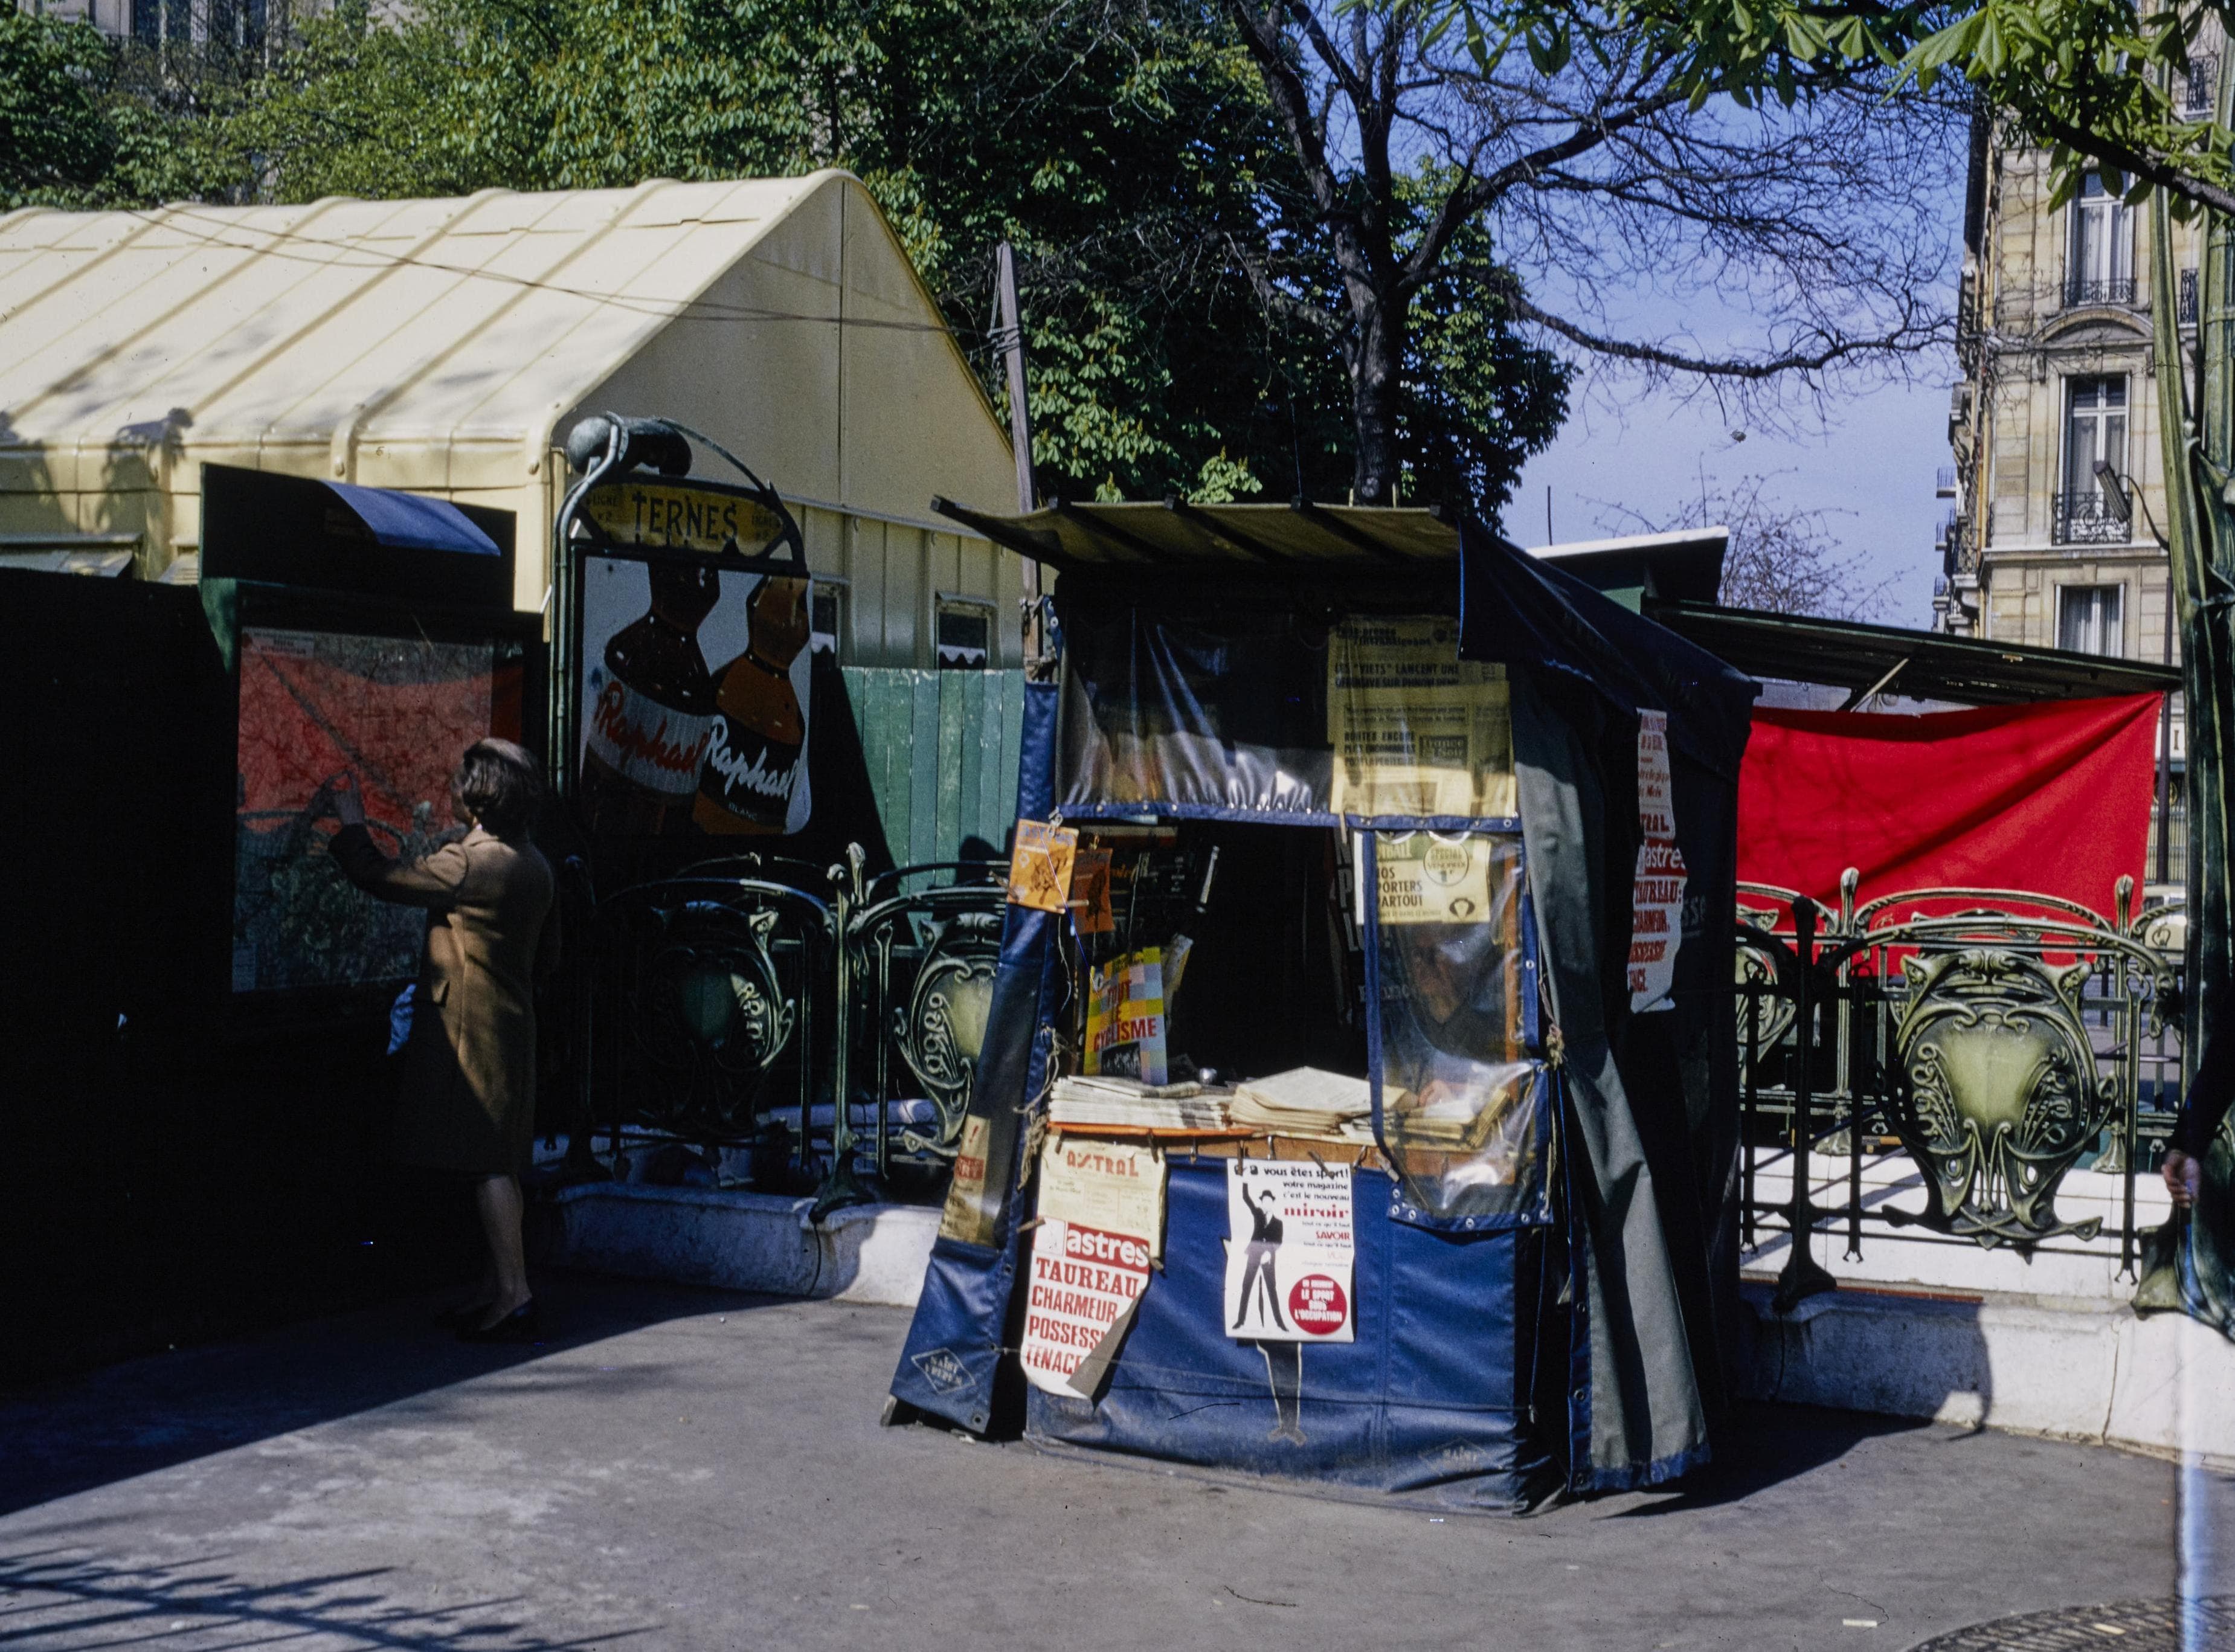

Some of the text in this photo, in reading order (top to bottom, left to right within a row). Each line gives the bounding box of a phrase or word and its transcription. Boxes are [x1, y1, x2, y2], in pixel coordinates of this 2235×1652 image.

[632, 490, 738, 541] TERNES
[728, 802, 758, 821] BLANC
[1377, 866, 1395, 879] OS
[1378, 895, 1423, 908] ARTOUT
[1067, 1150, 1139, 1178] ASTRAL
[1264, 1166, 1349, 1180] vous êtes sprt!
[1283, 1181, 1348, 1192] votre magazine
[1284, 1203, 1349, 1218] miroir
[1316, 1230, 1350, 1241] SAVOIR
[1066, 1229, 1150, 1268] astres
[1032, 1285, 1118, 1325] CHARMEUR
[1294, 1308, 1343, 1323] L'OCCUPATION
